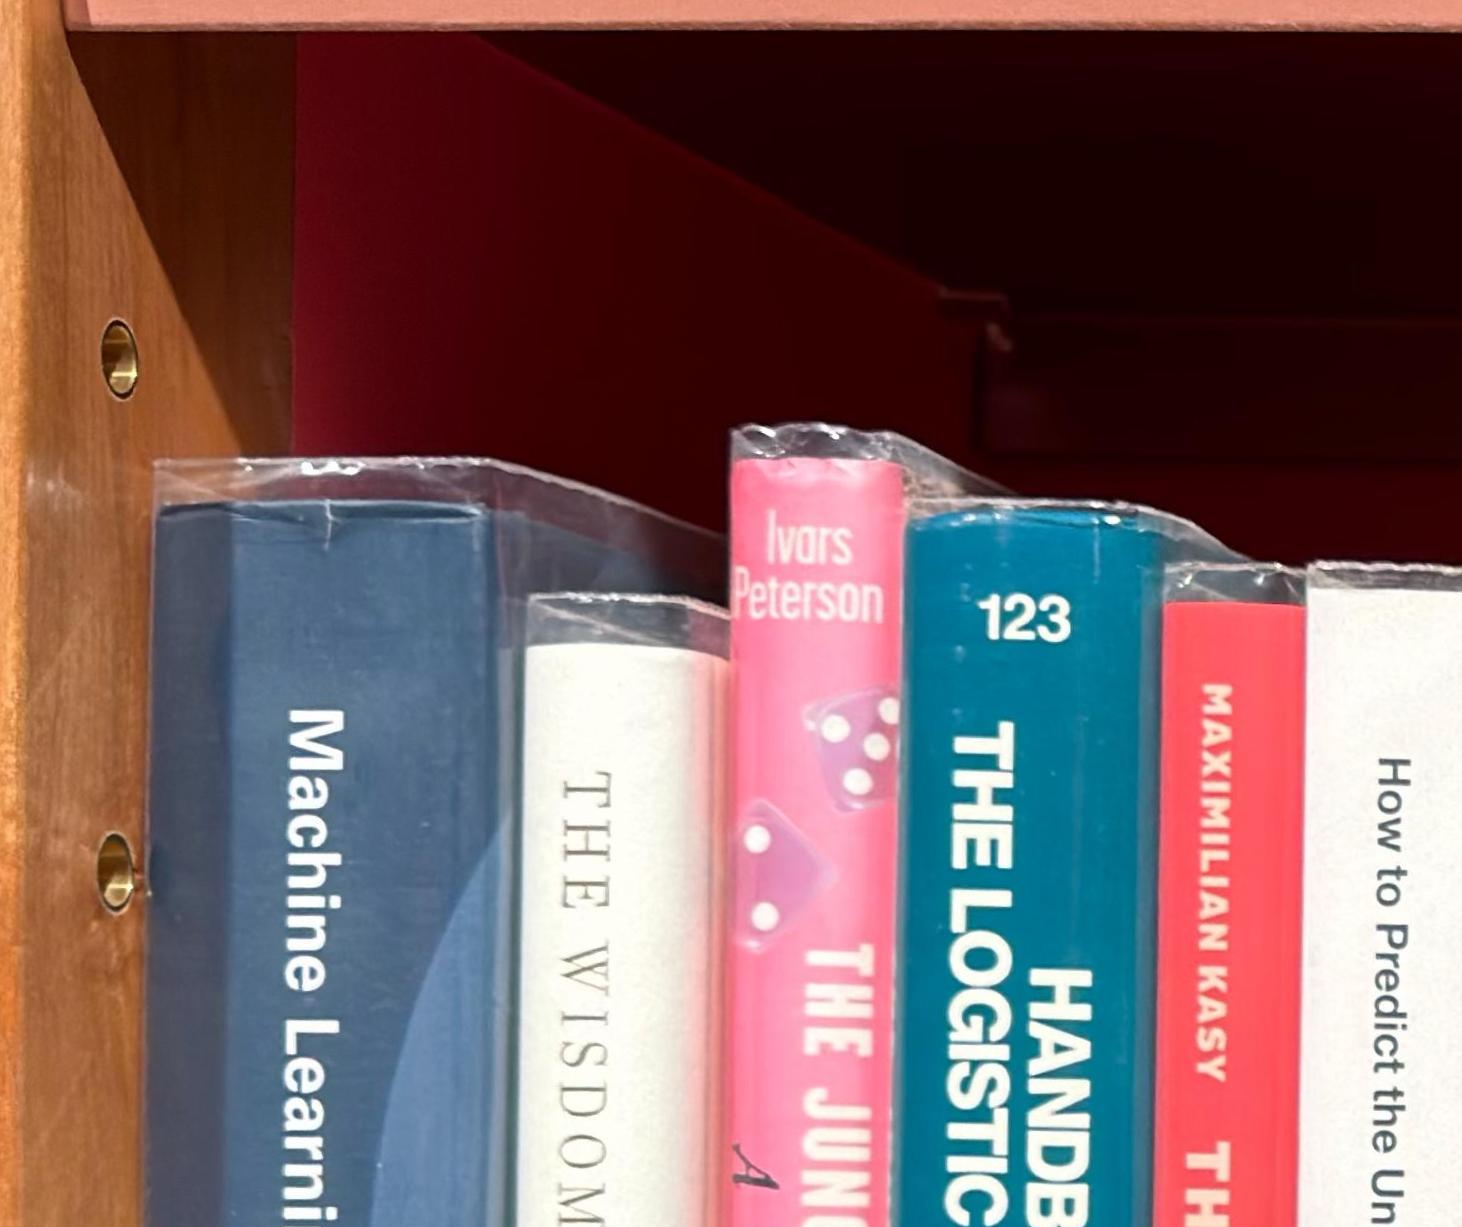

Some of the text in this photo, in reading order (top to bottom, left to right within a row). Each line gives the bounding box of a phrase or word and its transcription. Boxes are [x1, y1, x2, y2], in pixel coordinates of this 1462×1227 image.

[765, 510, 854, 566] Ivars
[733, 567, 884, 625] Peterson
[978, 595, 1071, 643] 123
[284, 709, 346, 993] Machine
[561, 772, 612, 910] THE
[951, 721, 1015, 870] THE
[1376, 757, 1411, 852] How
[1195, 684, 1232, 1083] MAXIMILIAN KASY
[1377, 864, 1409, 909] to
[804, 944, 874, 1057] THE
[1373, 923, 1409, 1073] Predict
[557, 942, 611, 1227] WISDOM
[944, 888, 1014, 1227] LOGISTIC
[731, 1143, 779, 1190] A
[1371, 1087, 1407, 1155] the
